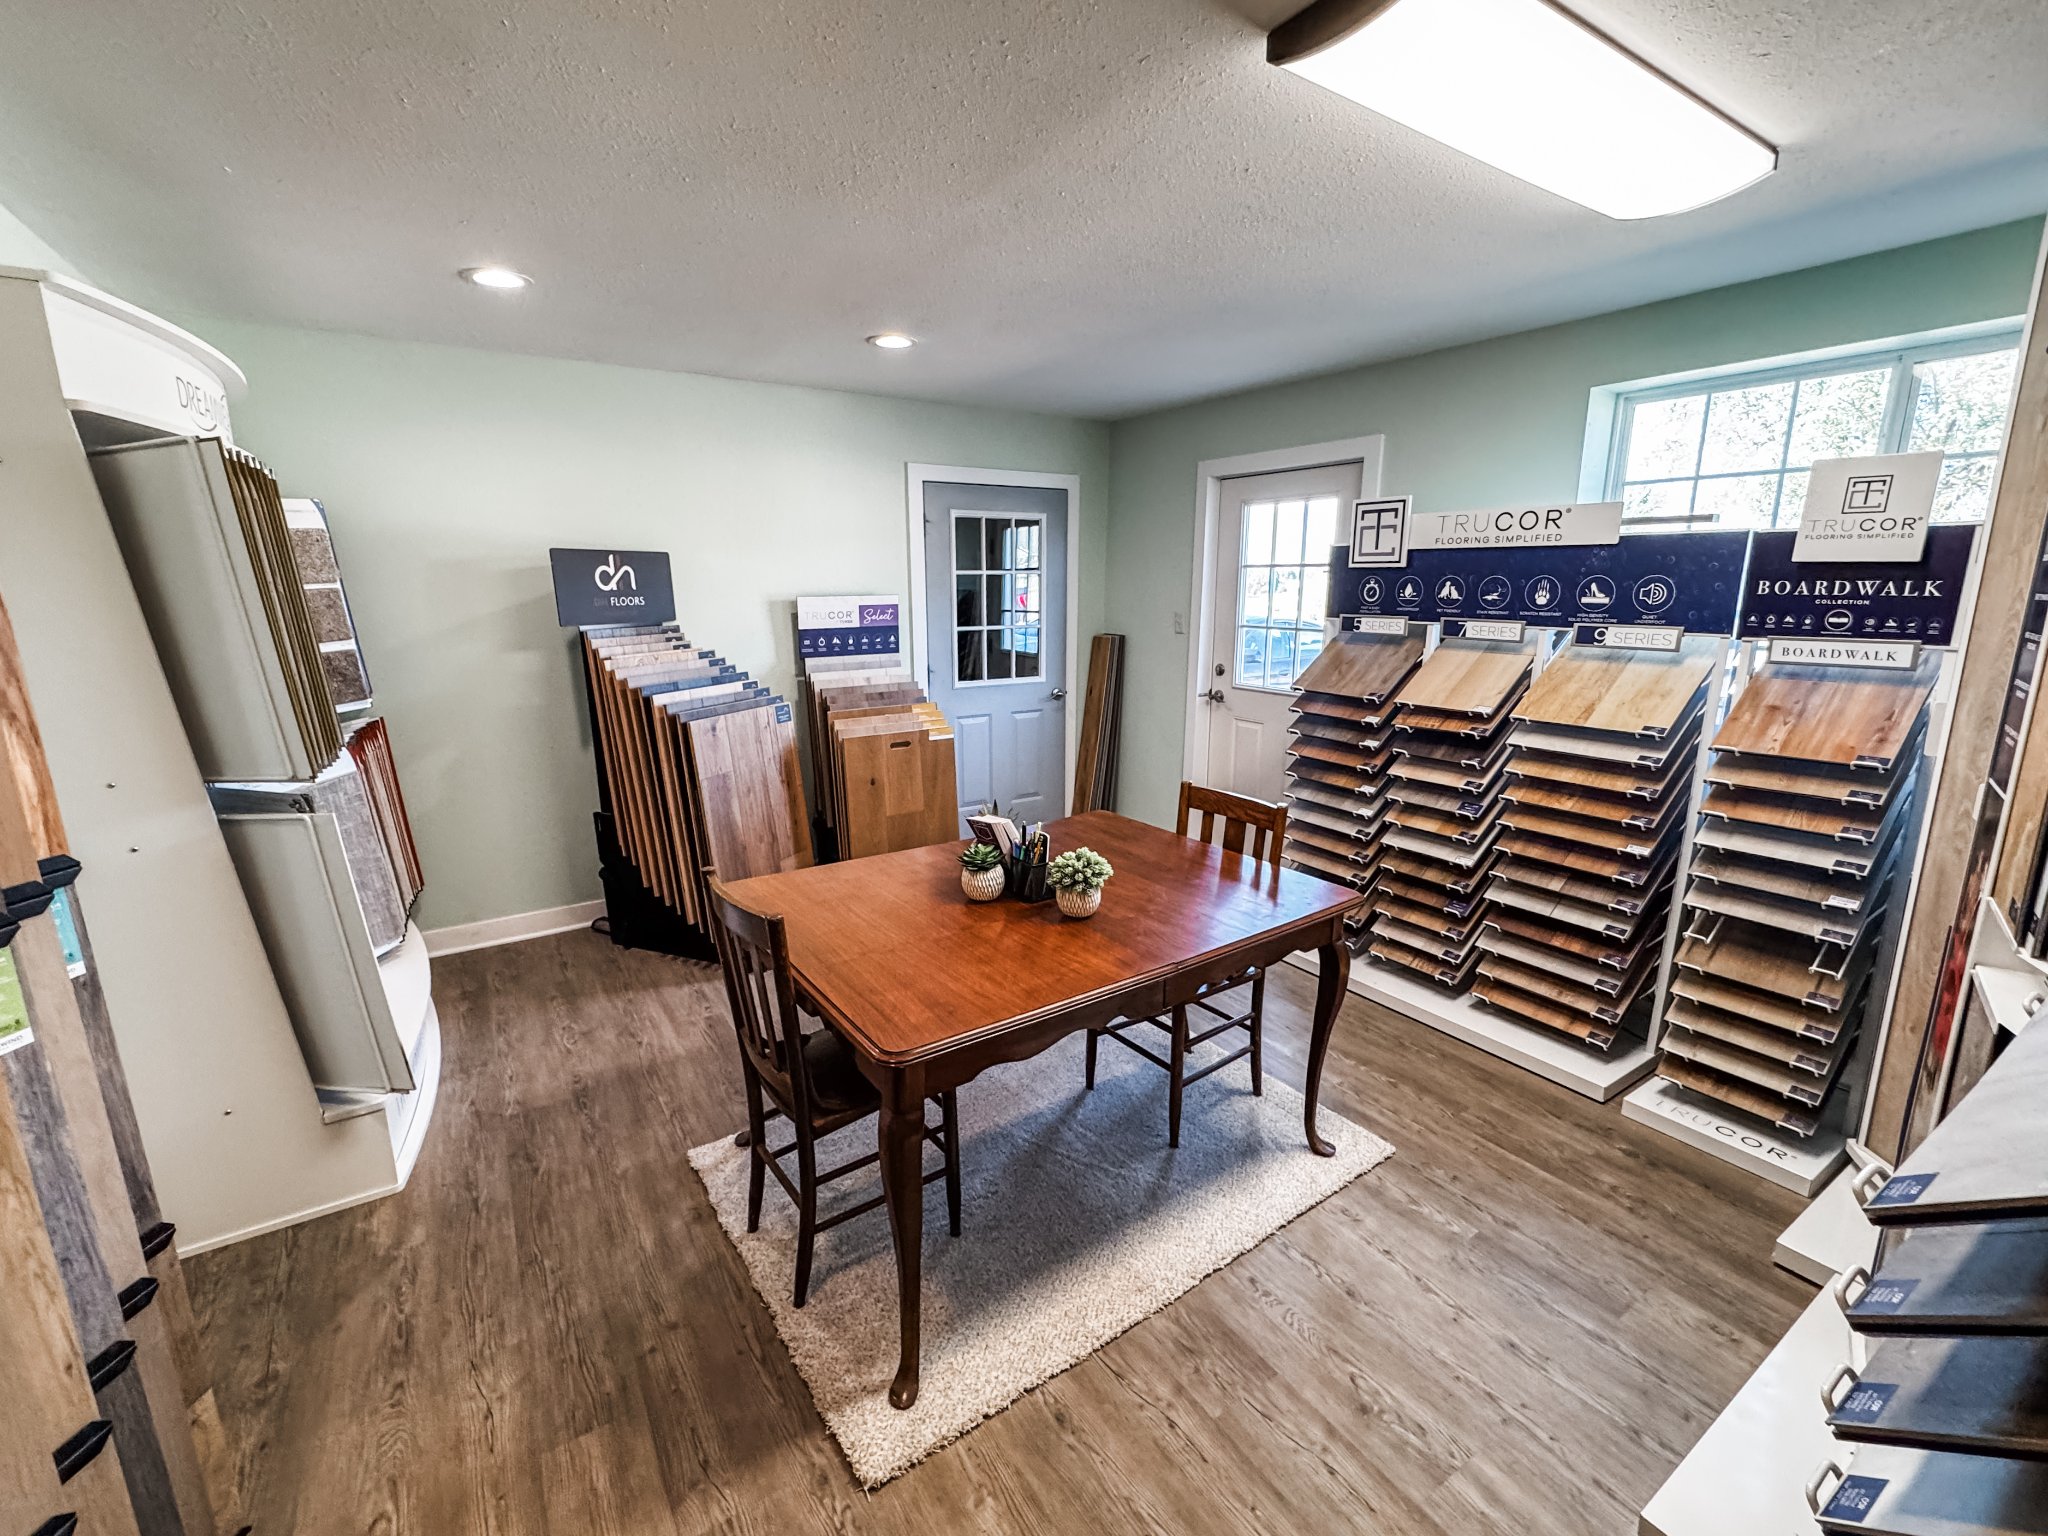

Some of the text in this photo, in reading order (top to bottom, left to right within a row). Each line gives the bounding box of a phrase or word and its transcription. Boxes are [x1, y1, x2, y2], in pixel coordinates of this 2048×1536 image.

[1434, 532, 1563, 546] FLOORING SIMPLIFIED
[1804, 531, 1915, 541] FLOORING SIMPLIFIED
[1756, 579, 1944, 597] BOARDWALK
[610, 596, 646, 607] FLOORS
[863, 607, 895, 625] Select
[1365, 620, 1402, 632] SERIES
[1471, 625, 1518, 639] SERIES
[1593, 627, 1674, 647] 9 SERIES
[1781, 646, 1898, 662] BOARDWALK
